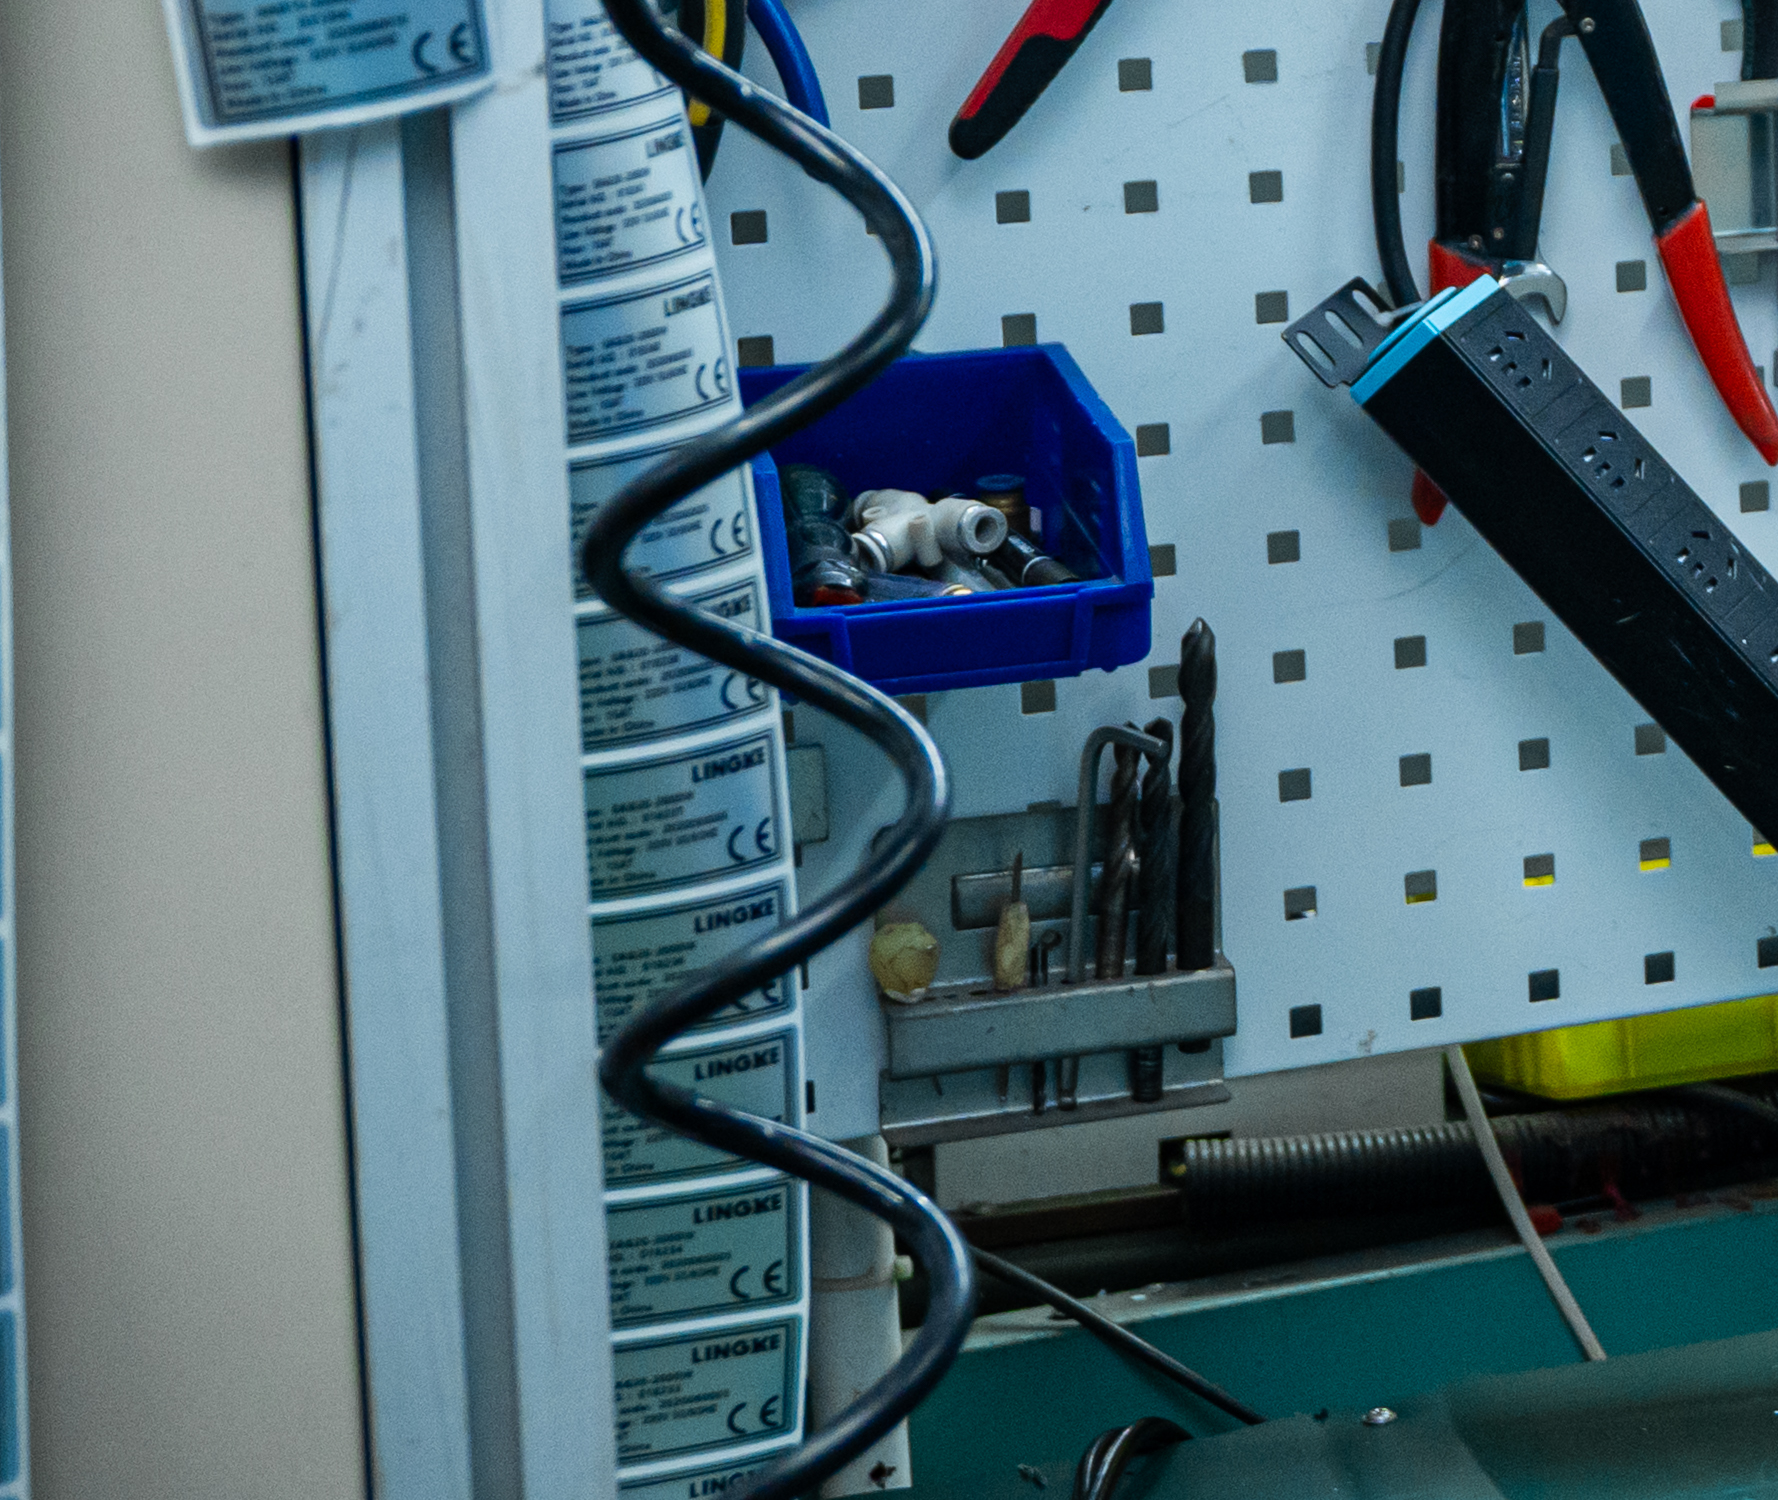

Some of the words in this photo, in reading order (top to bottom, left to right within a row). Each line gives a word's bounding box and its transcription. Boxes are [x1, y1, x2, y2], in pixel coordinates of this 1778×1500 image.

[694, 1047, 779, 1081] LINGKE
[693, 1191, 783, 1225] LINGKE
[691, 1333, 781, 1365] LINGKE
